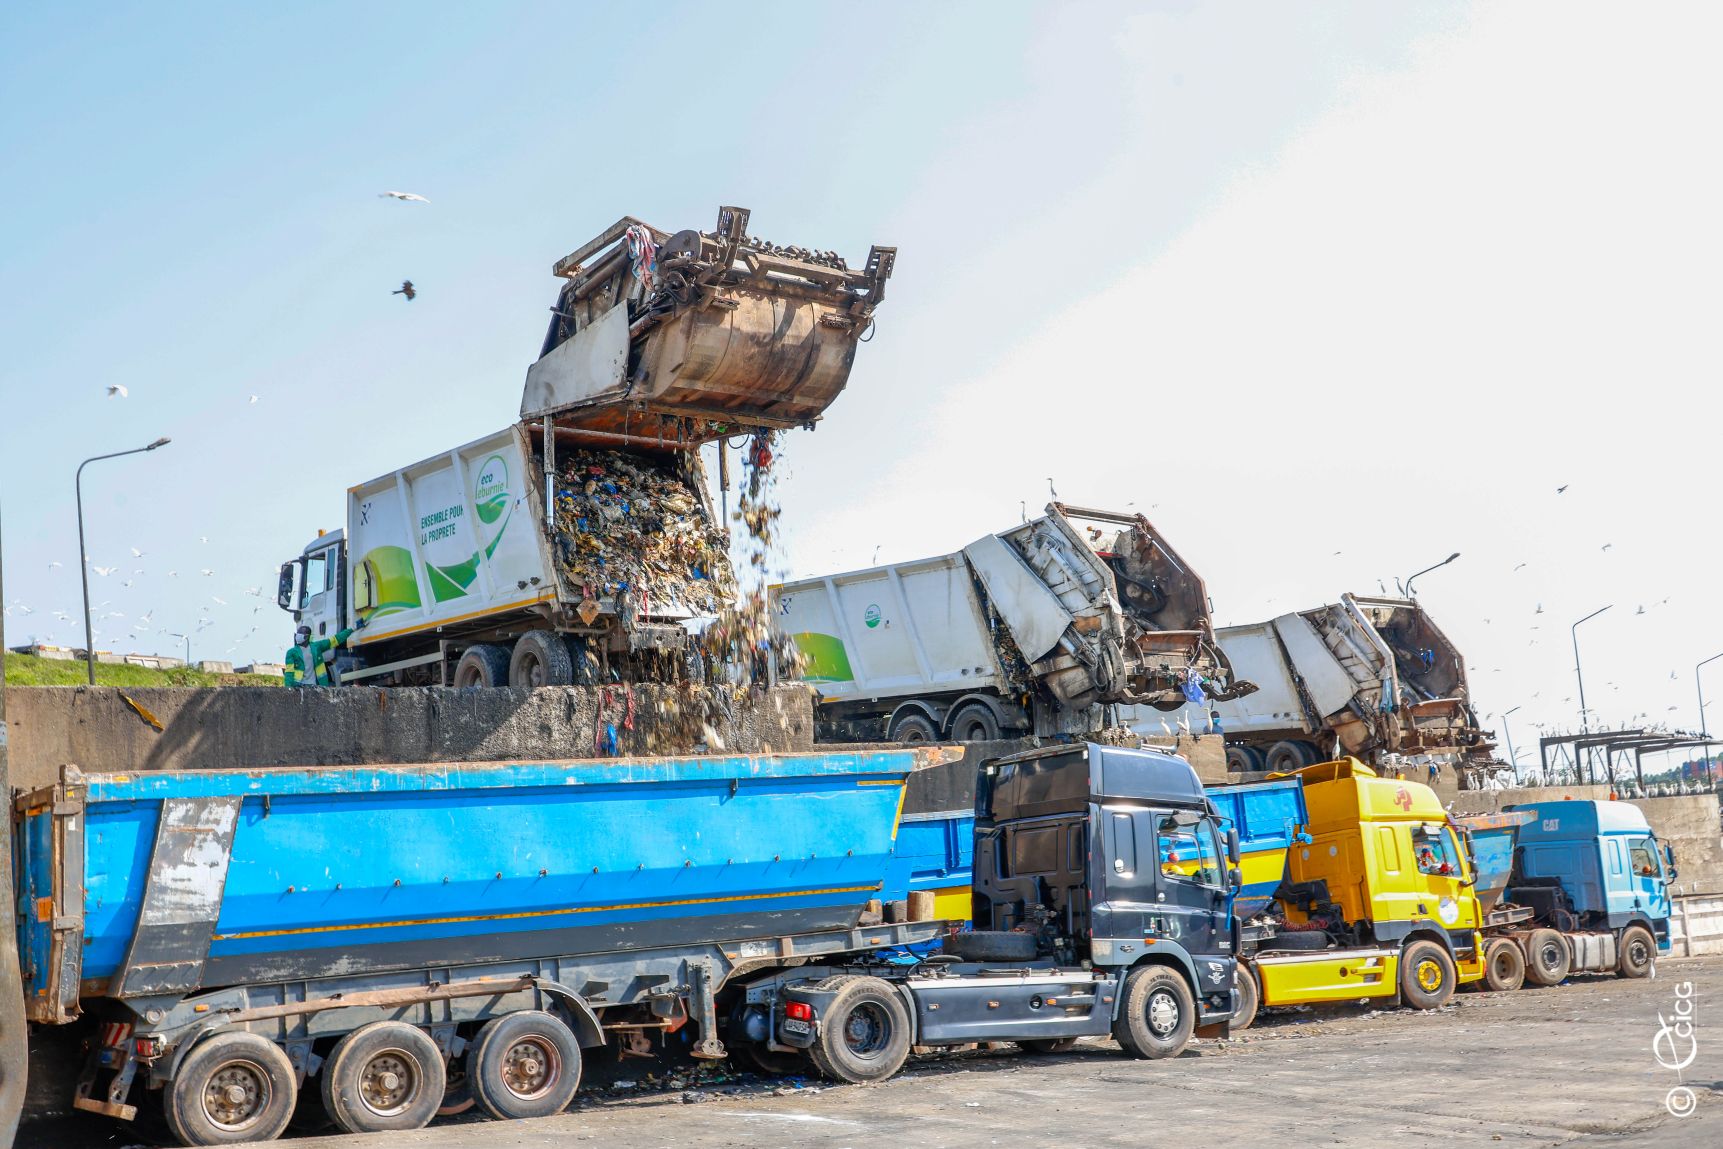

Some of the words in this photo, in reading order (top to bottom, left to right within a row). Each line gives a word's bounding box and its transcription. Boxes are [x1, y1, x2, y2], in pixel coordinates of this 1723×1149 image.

[481, 473, 493, 485] eco
[421, 509, 448, 529] ENSEMBLE
[421, 533, 428, 545] LA
[428, 522, 456, 542] PROPRETE
[1543, 818, 1560, 831] CAT
